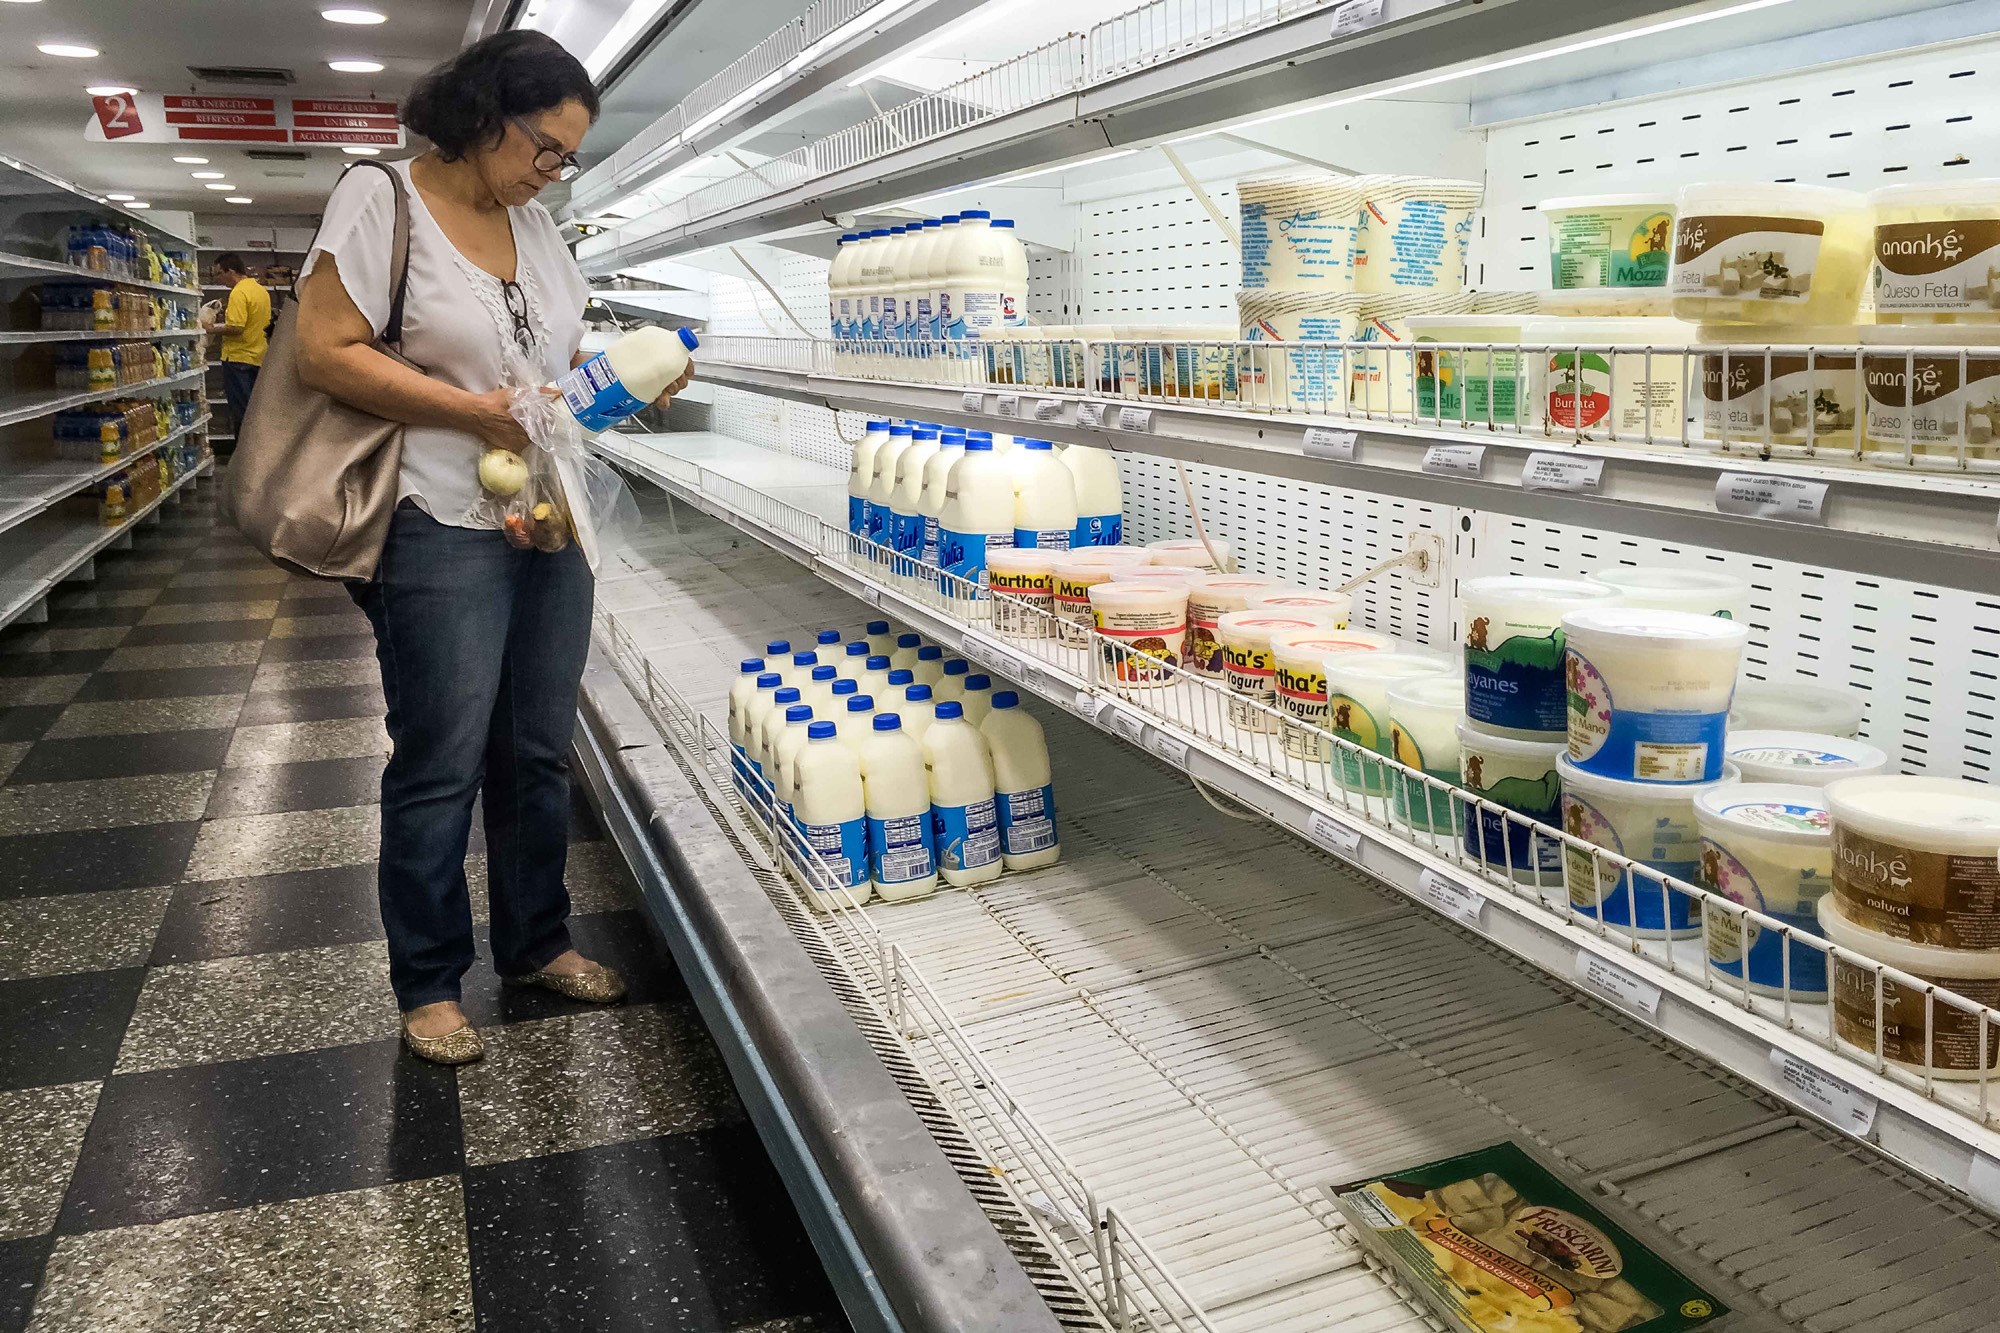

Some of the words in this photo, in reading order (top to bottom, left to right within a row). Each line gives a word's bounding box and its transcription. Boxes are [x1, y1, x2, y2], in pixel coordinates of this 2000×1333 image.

[105, 97, 129, 128] 2
[312, 103, 378, 112] REFRIGERADOS
[196, 115, 245, 123] REFRESCOS
[324, 119, 368, 128] UNTABLES
[300, 132, 330, 141] AGUAS
[331, 134, 392, 143] SABORIZADAS
[1882, 229, 1958, 259] ananké
[1682, 271, 1701, 284] Feta
[1883, 283, 1920, 299] Queso
[1924, 282, 1959, 298] Feta
[1728, 410, 1748, 423] eta
[1870, 411, 1901, 429] Queso
[1912, 415, 1938, 431] eta
[1227, 670, 1265, 690] Yogurt
[1283, 695, 1329, 717] Yogurt
[1579, 717, 1606, 736] Mano
[1571, 860, 1581, 871] de
[1583, 864, 1616, 883] Mno
[1867, 898, 1911, 917] natural
[1858, 1016, 1900, 1036] natral
[1804, 1067, 1820, 1080] QUESO
[1820, 1076, 1842, 1092] NATURAL
[1842, 1086, 1850, 1095] DE
[1515, 1209, 1618, 1275] FRESCARINI
[1437, 1237, 1455, 1251] CON
[1455, 1244, 1495, 1271] CUATRO
[1494, 1268, 1530, 1291] QUESOS
[1440, 1227, 1494, 1259] RAVIOLIS
[1493, 1256, 1559, 1293] RELLENOS
